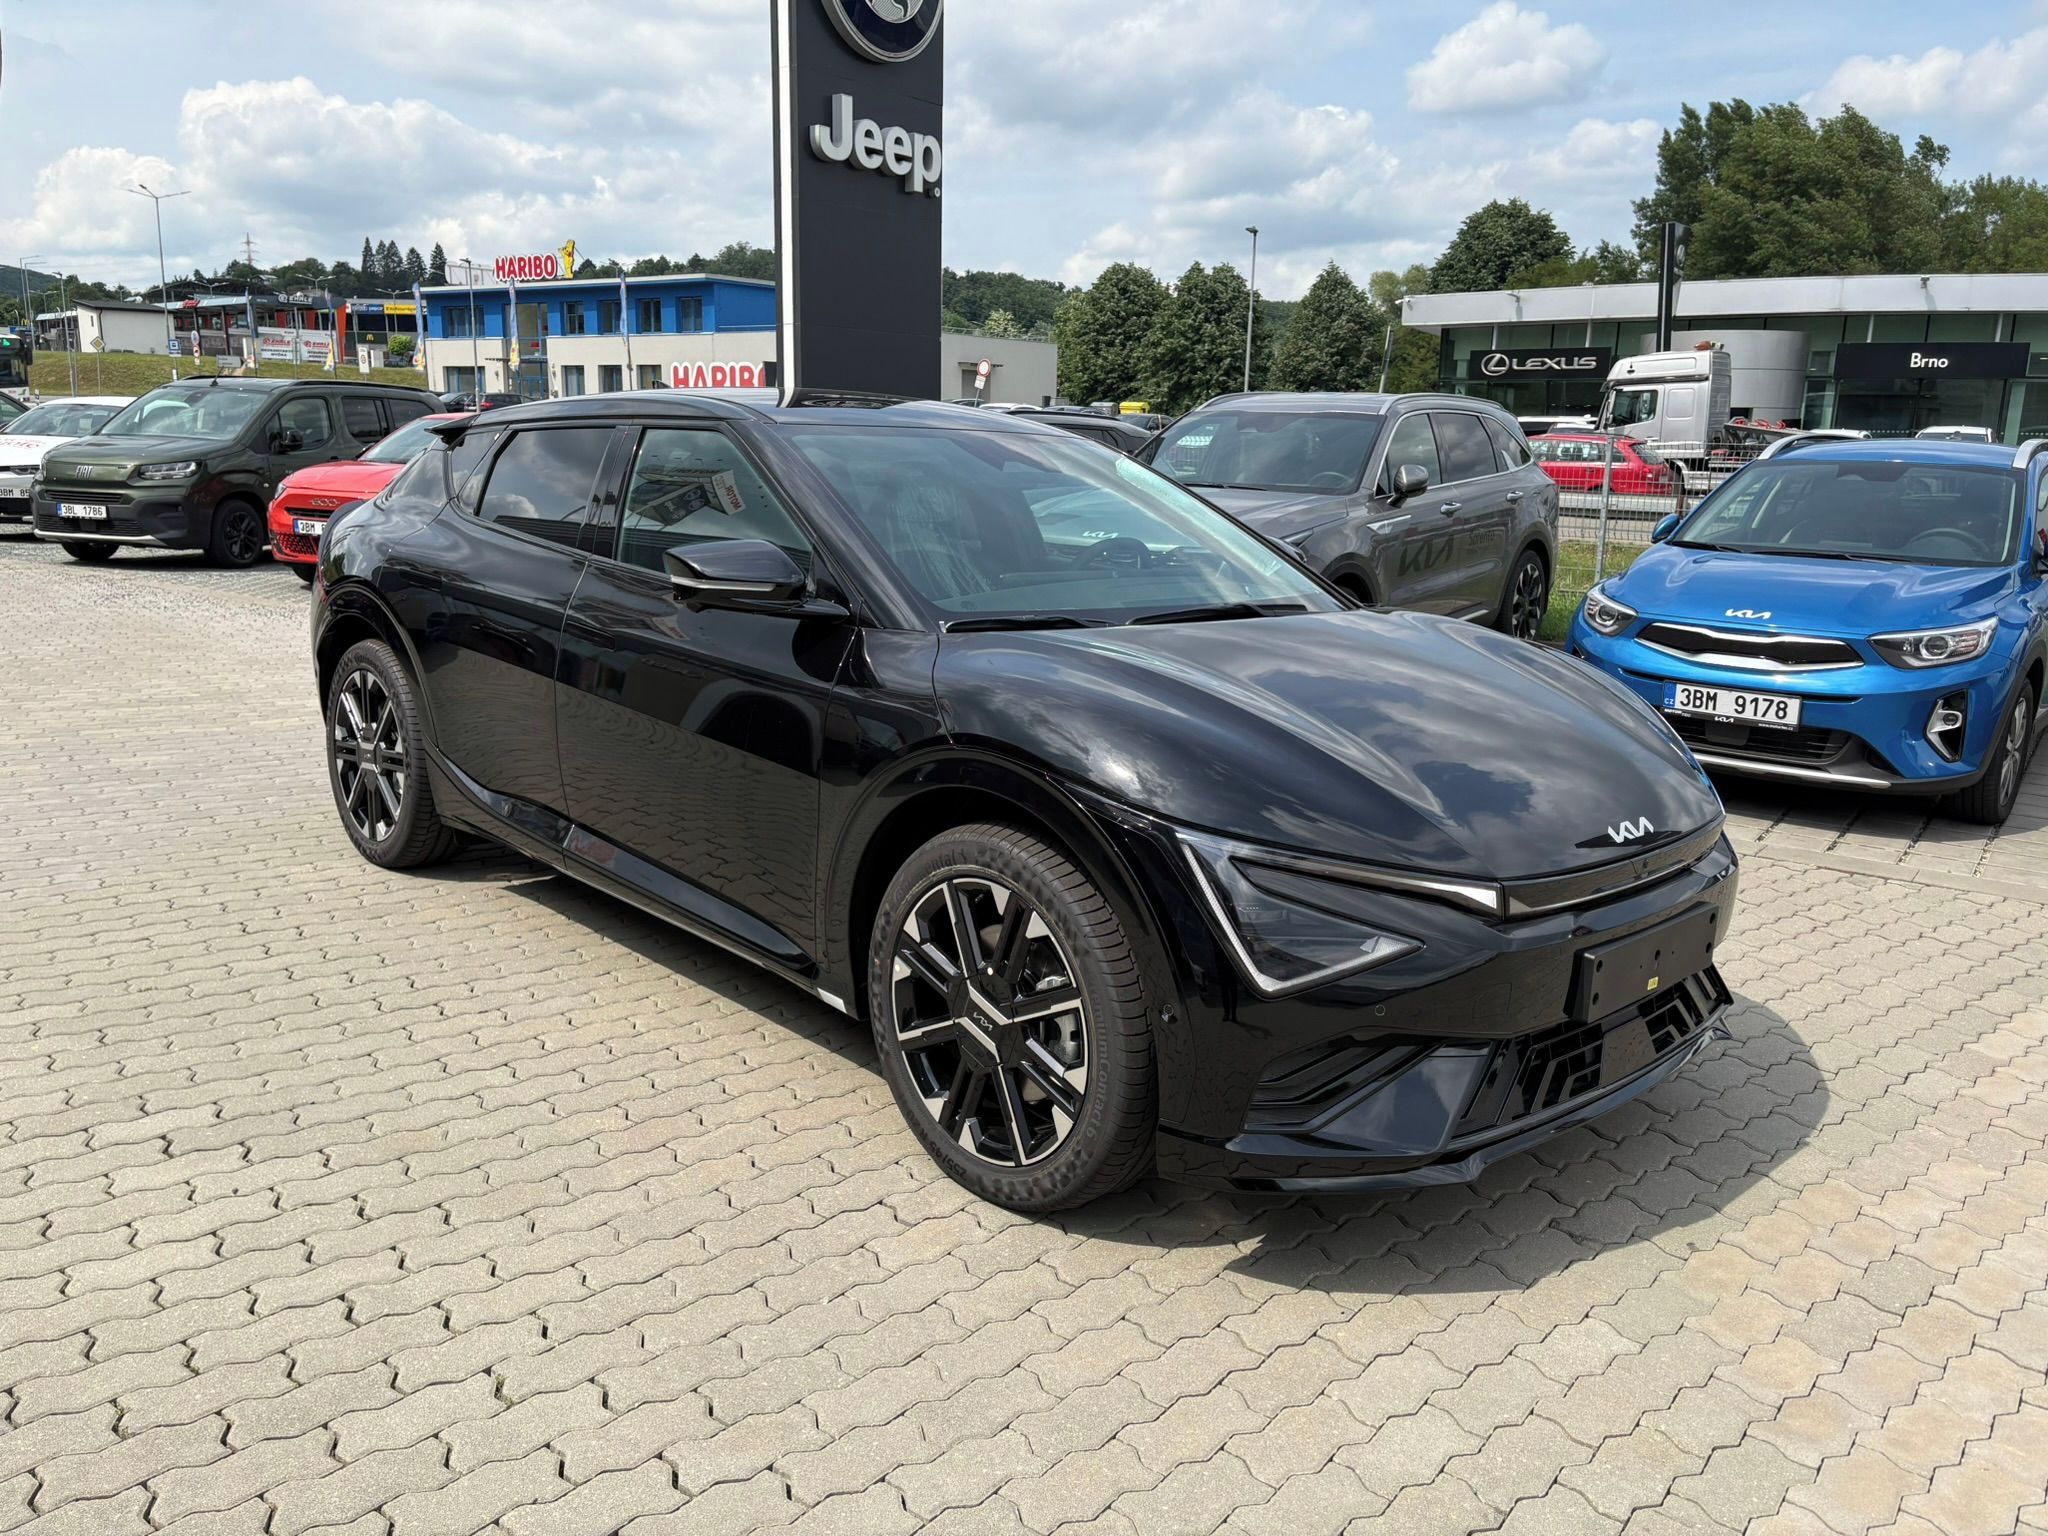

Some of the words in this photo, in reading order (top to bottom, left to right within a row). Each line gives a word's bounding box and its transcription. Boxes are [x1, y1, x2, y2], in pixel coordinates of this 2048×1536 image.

[810, 93, 942, 193] Jeep
[494, 253, 557, 281] HARIBO
[1511, 356, 1598, 370] LEXUS
[1910, 352, 1949, 369] Brno
[672, 364, 766, 389] HARIB
[75, 465, 94, 480] FIAT
[62, 504, 77, 516] 3BL
[82, 506, 104, 517] 1786
[1725, 608, 1772, 620] KIA
[1679, 687, 1718, 712] 3BM
[1734, 694, 1788, 720] 9178
[1714, 715, 1734, 723] KIA
[1607, 816, 1655, 844] KIA
